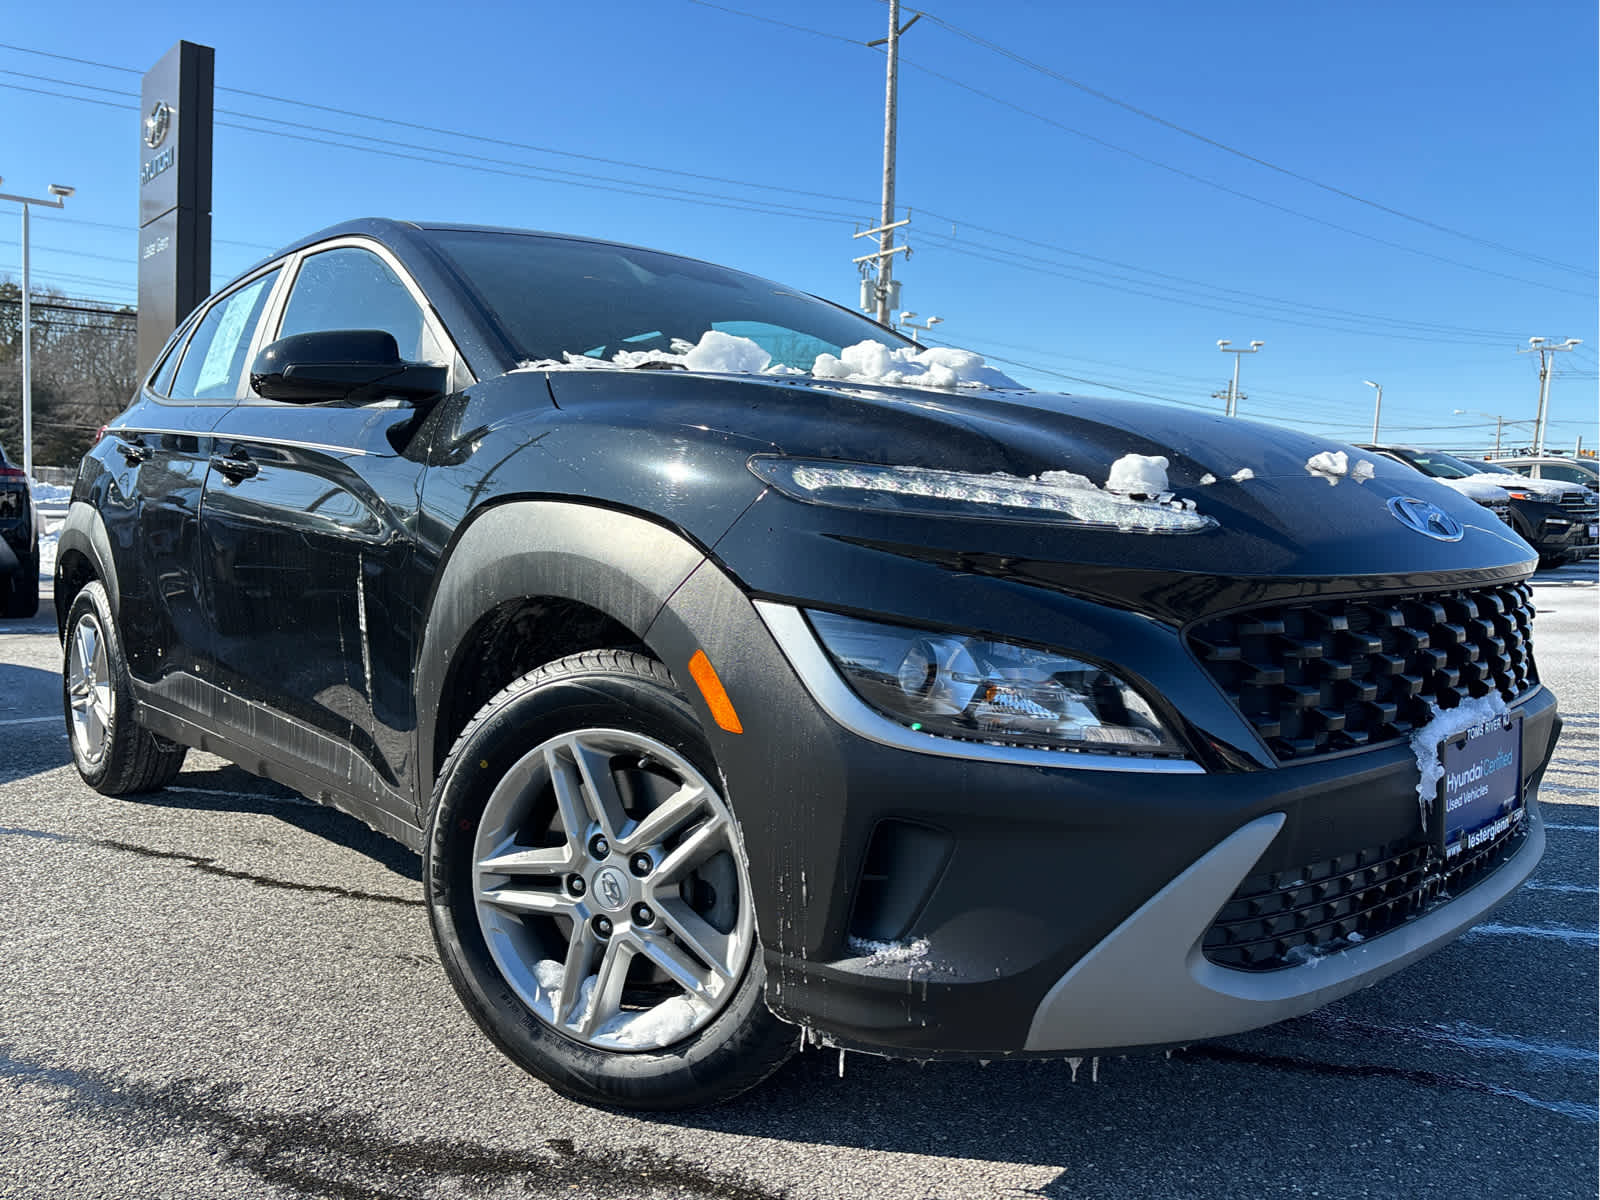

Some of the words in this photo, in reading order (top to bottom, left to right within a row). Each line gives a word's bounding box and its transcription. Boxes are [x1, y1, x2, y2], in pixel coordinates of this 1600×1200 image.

[1467, 726, 1484, 741] TOMS
[1485, 718, 1501, 734] RIVER
[1446, 760, 1483, 794] Hyundai
[1484, 747, 1513, 777] Certified
[1446, 794, 1463, 813] Used
[1463, 784, 1489, 804] Vehicles
